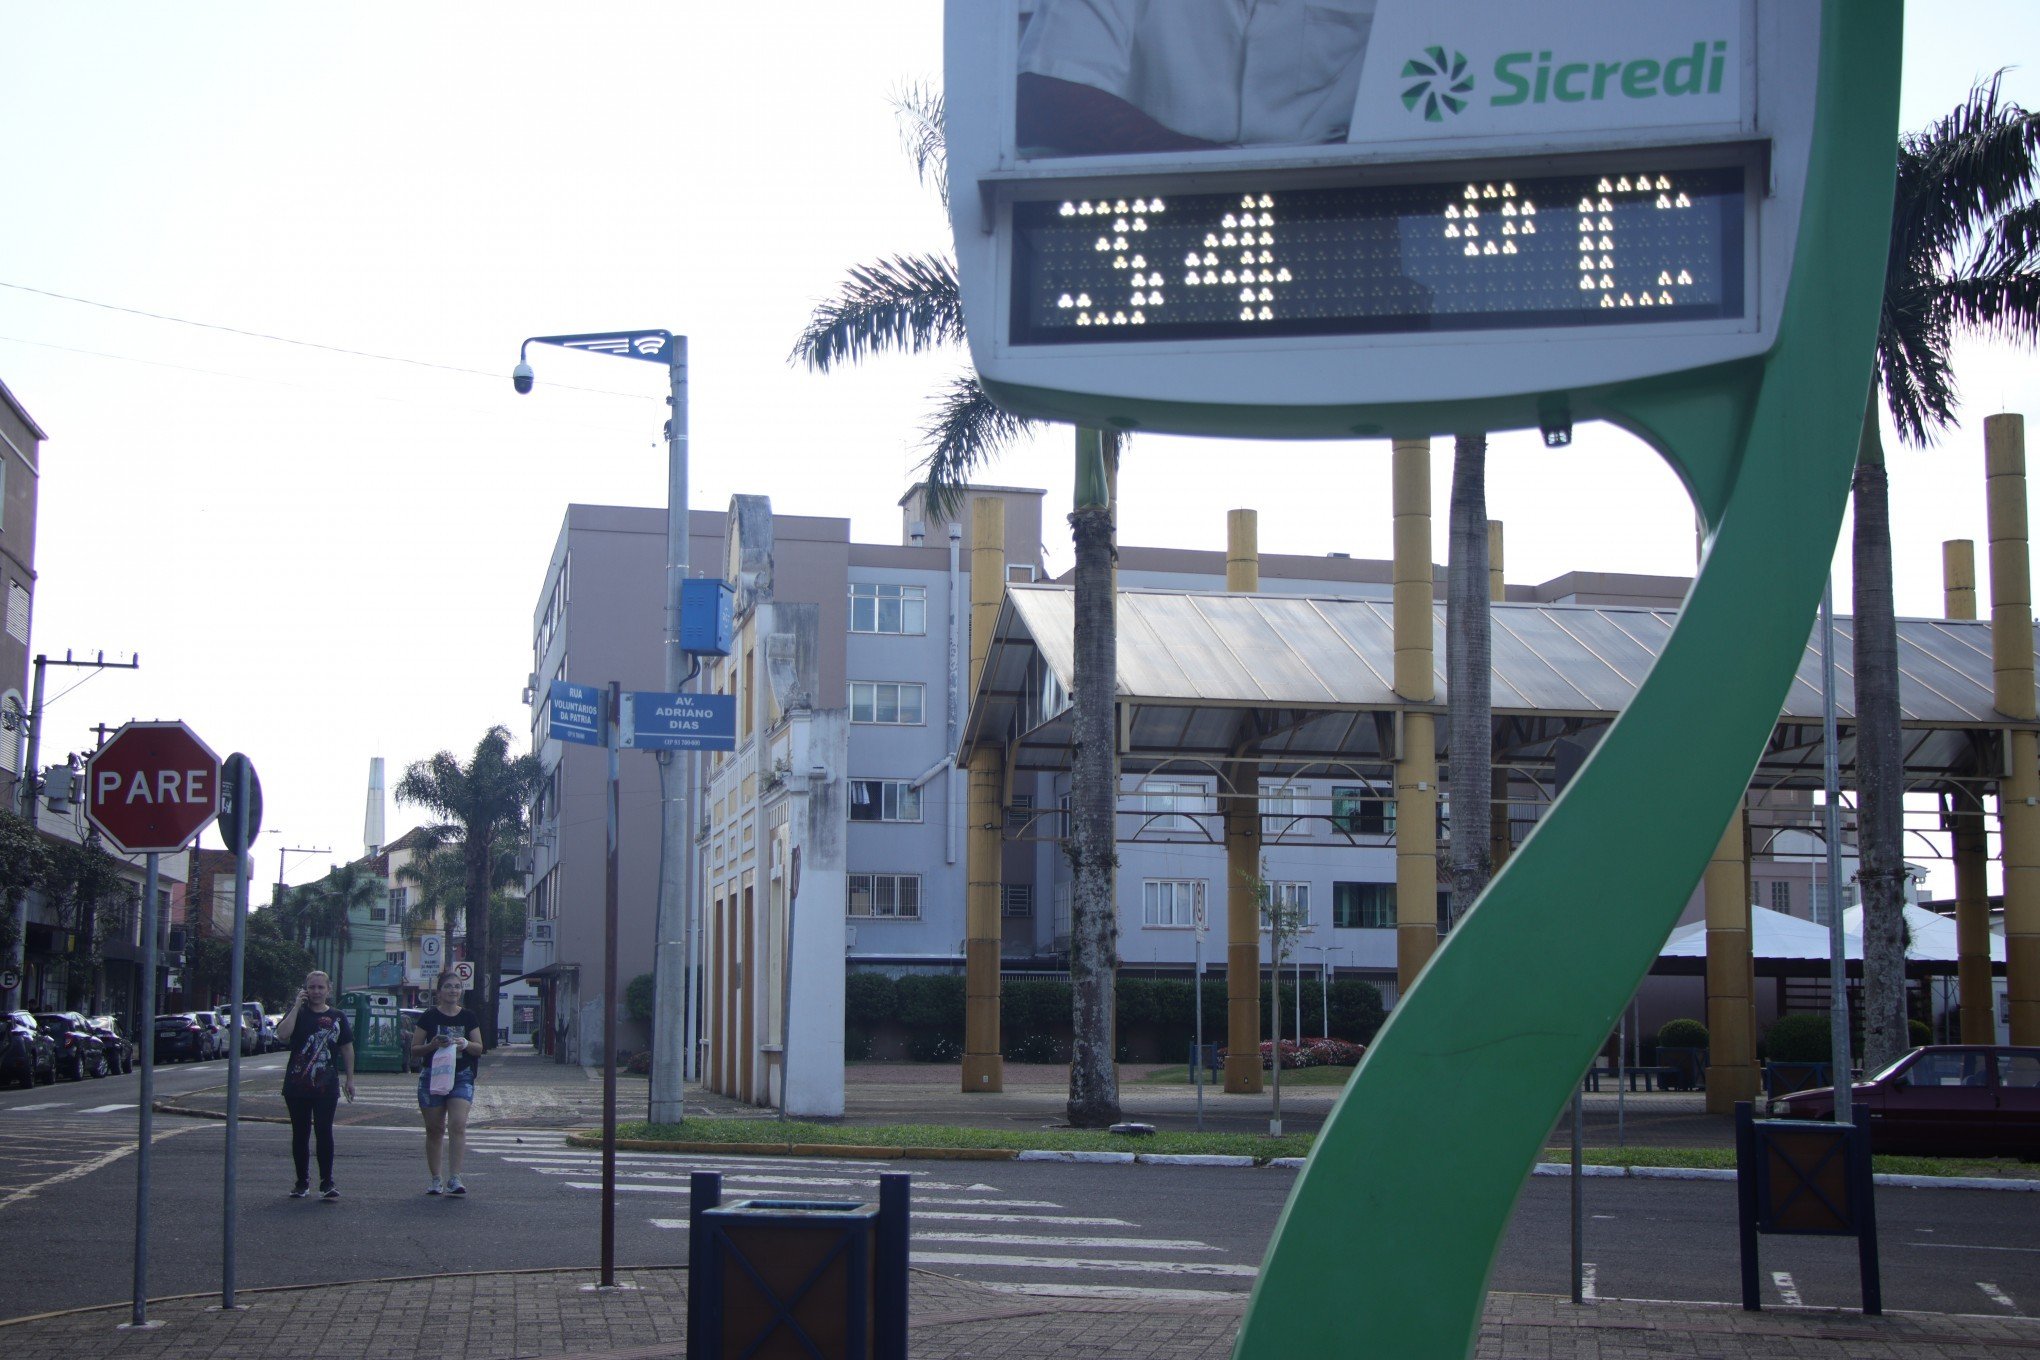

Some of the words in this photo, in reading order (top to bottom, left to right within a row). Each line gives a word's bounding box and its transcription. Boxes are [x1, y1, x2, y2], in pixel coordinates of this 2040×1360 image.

[1490, 41, 1727, 107] Sicredi
[1060, 193, 1292, 326] 34
[569, 687, 583, 699] RUA
[675, 697, 695, 706] AV.
[560, 711, 569, 721] DA
[655, 707, 714, 719] ADRIANO
[669, 720, 700, 730] DIAS
[98, 769, 208, 805] PARE
